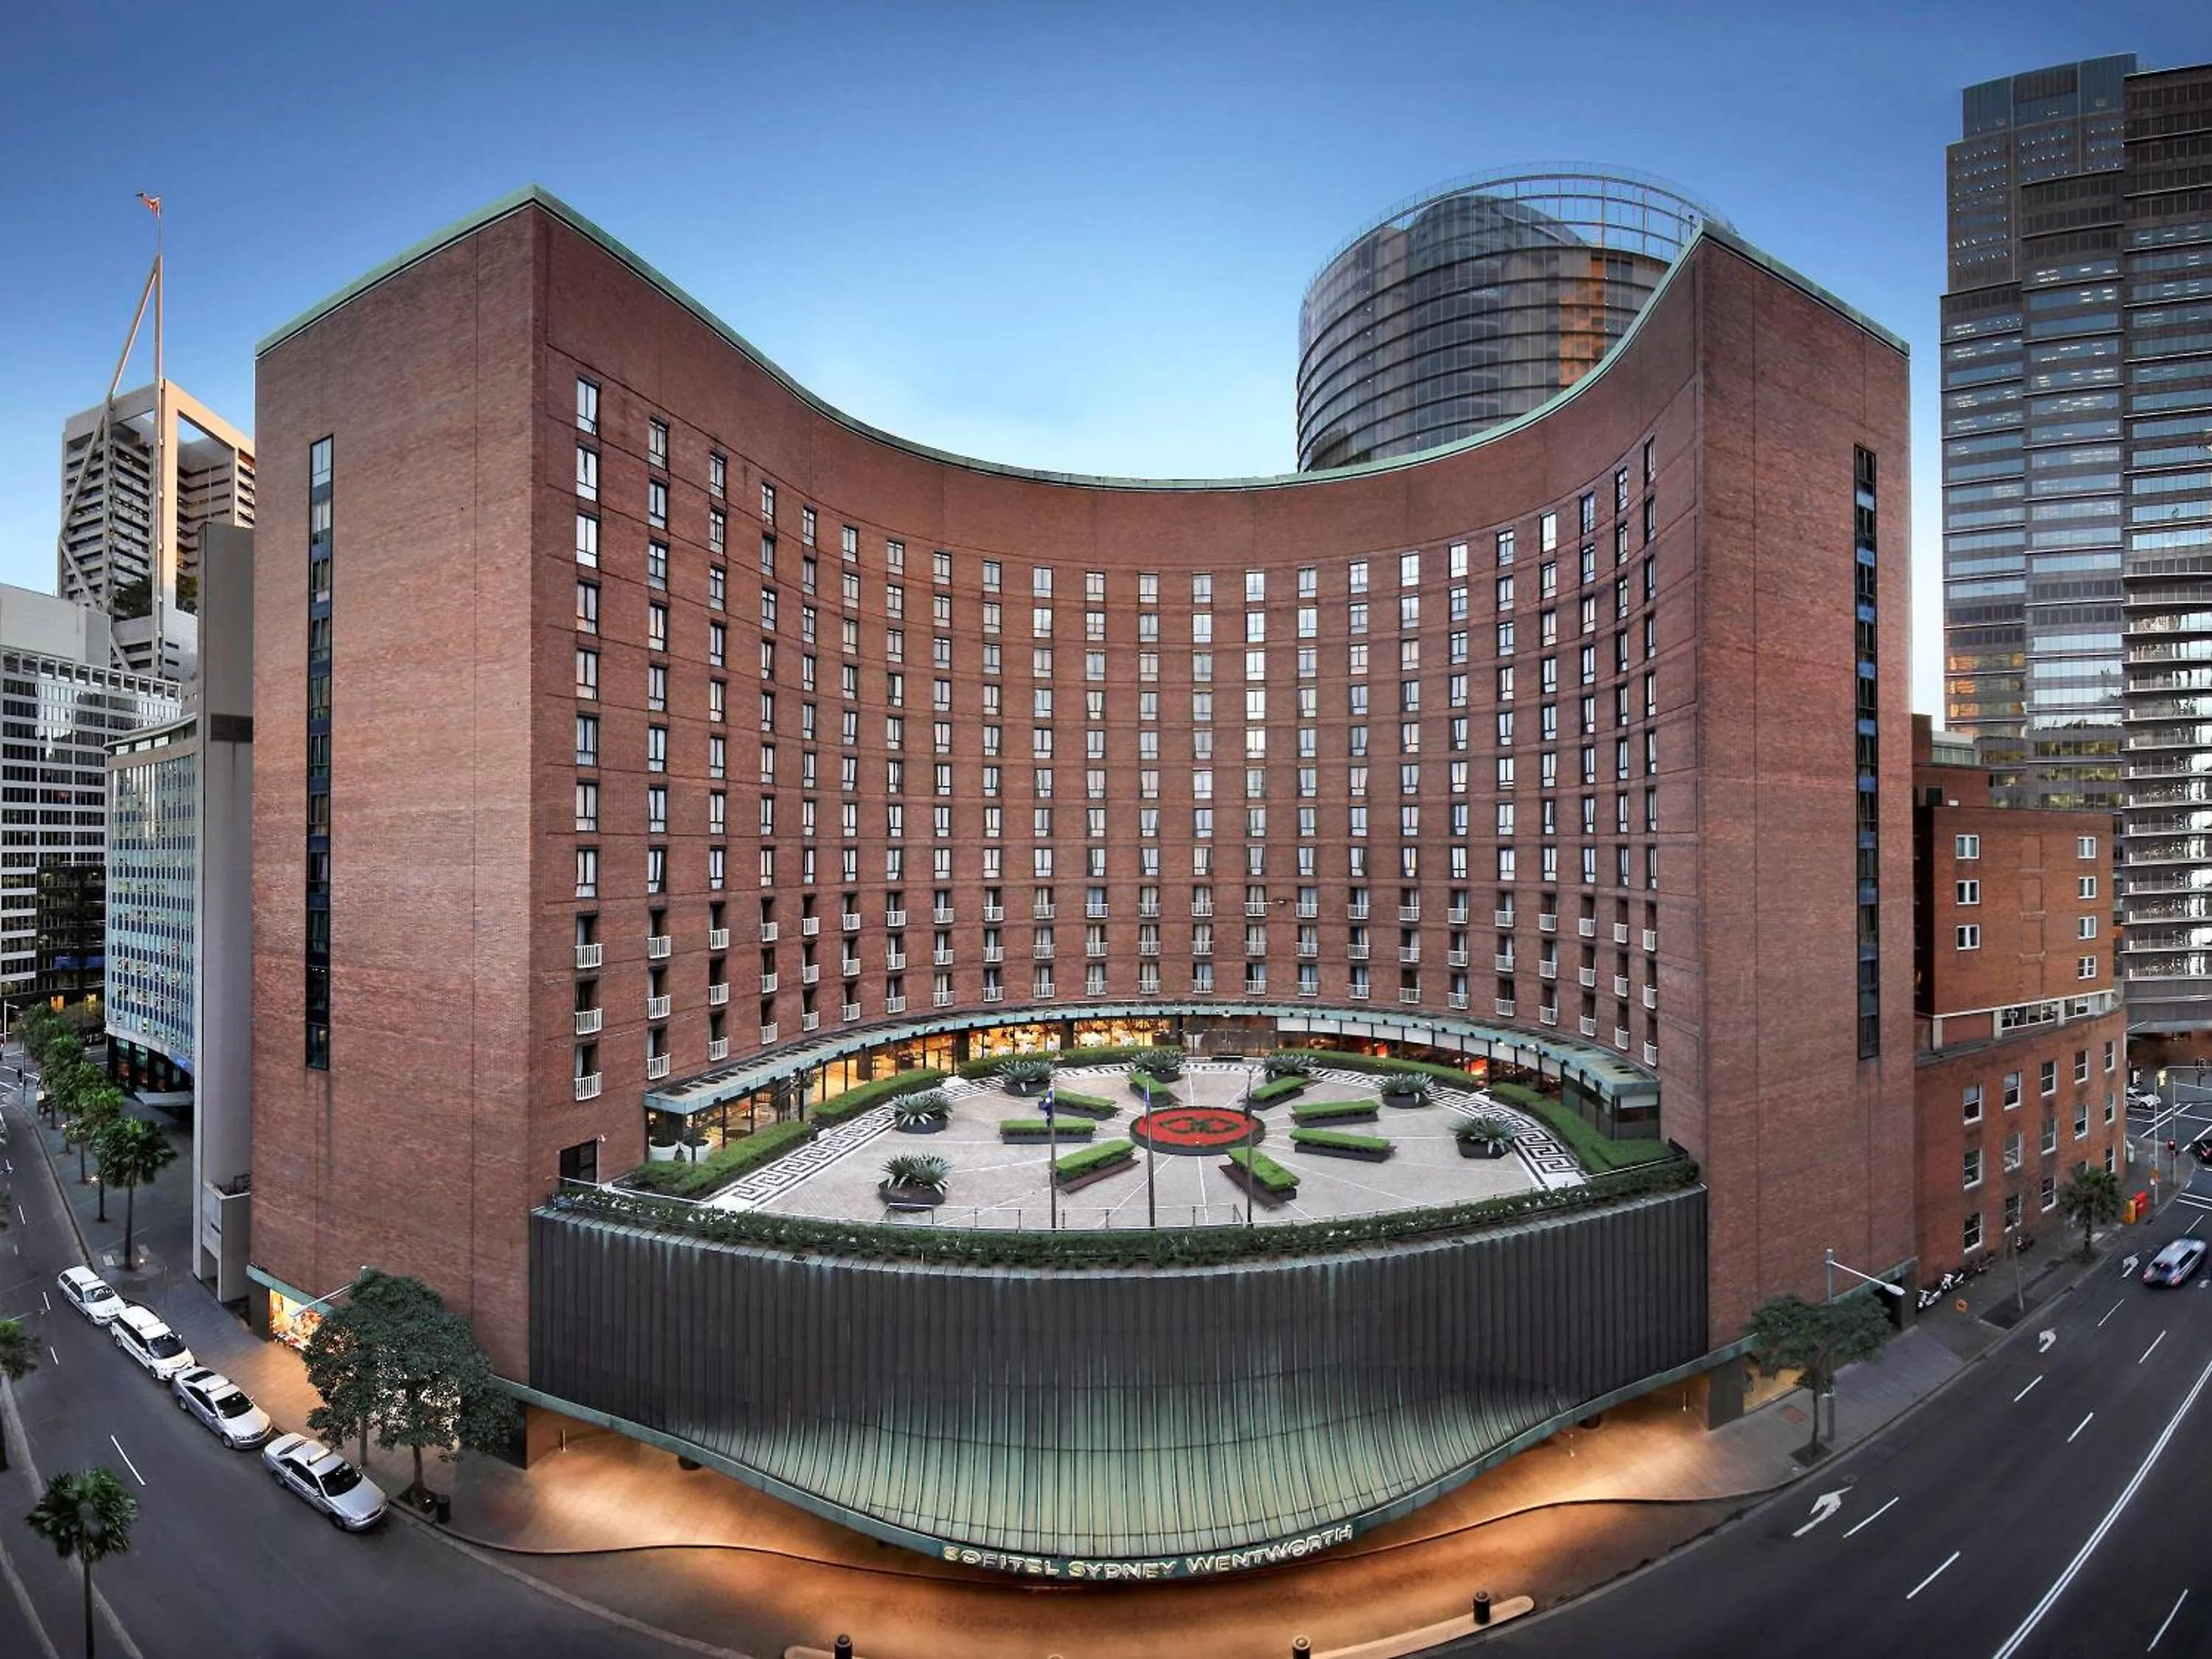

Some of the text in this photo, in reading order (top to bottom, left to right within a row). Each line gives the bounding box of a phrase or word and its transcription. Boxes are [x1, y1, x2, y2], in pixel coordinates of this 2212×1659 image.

[944, 1524, 1352, 1579] SOFITEL SYDNEY WENTWORTH
